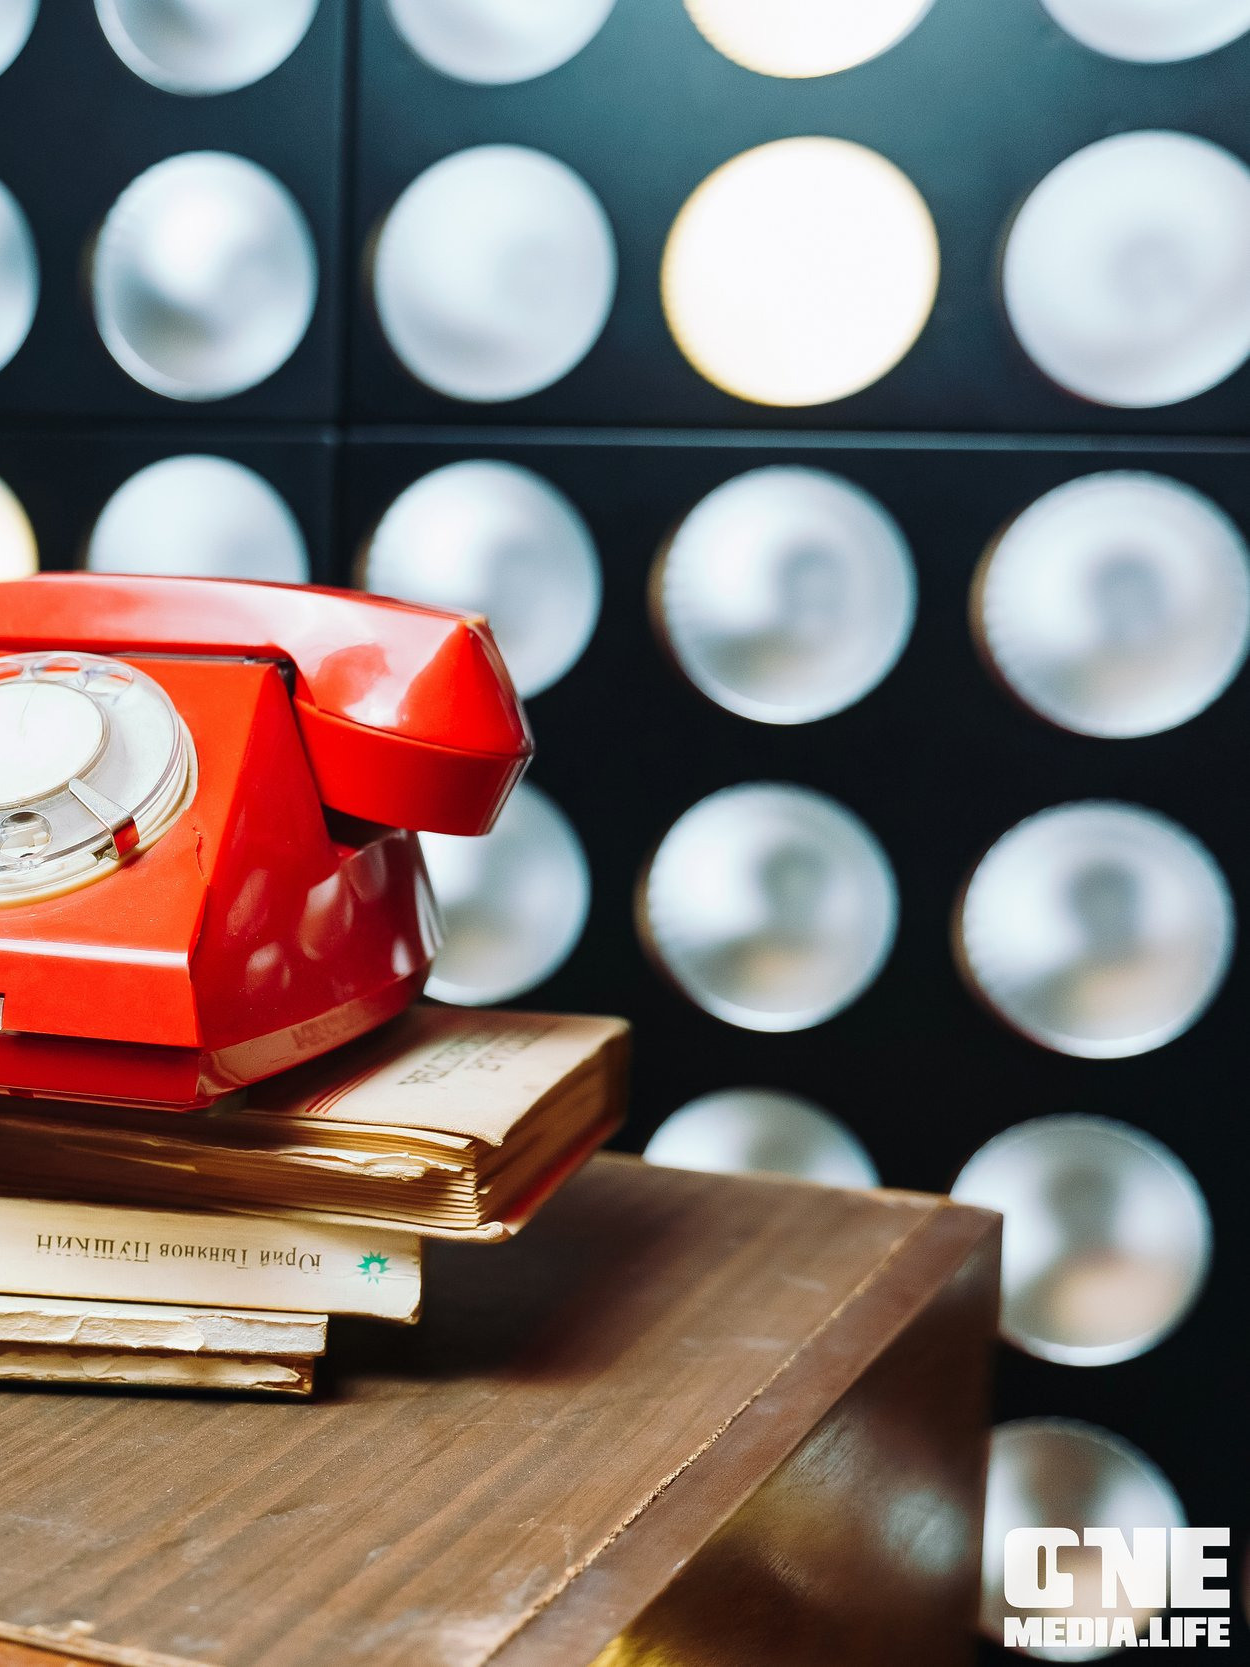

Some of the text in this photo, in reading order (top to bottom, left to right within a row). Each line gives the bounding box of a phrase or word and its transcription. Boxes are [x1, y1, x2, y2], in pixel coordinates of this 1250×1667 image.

[36, 1233, 322, 1274] Юрий Тынянов ПУШКИН
